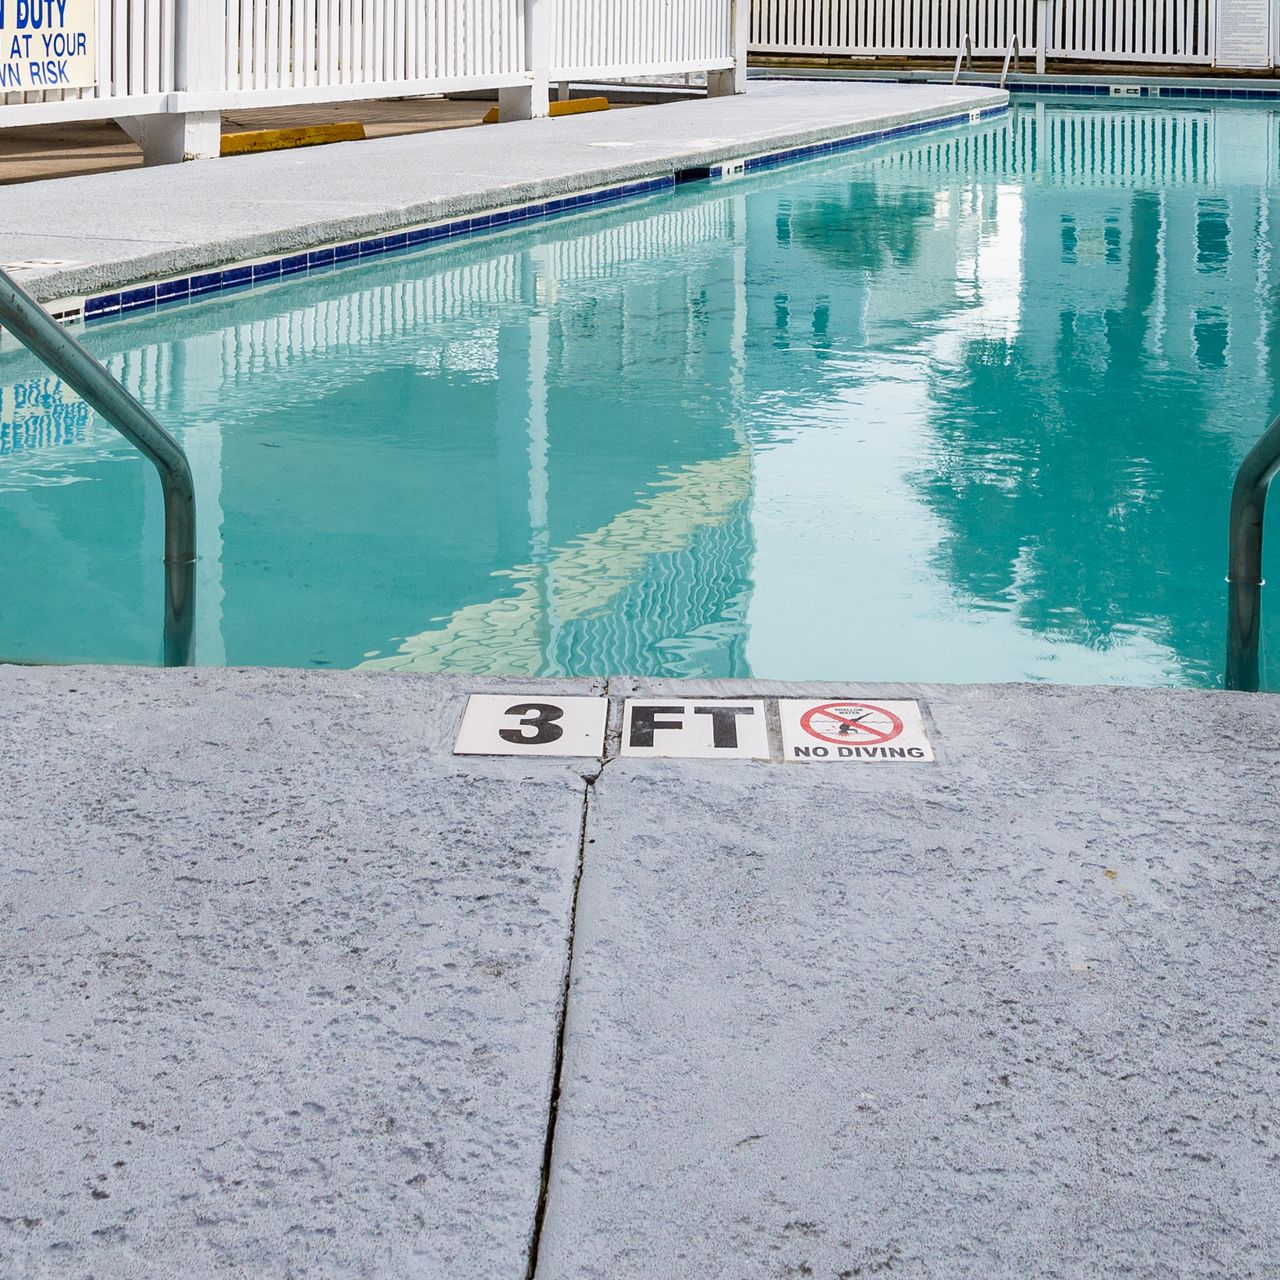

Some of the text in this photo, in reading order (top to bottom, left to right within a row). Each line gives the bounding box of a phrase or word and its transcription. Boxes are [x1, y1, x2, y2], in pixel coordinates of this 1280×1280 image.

[10, 34, 32, 59] AT
[41, 32, 87, 58] YOUR
[29, 60, 70, 86] RISK
[498, 702, 755, 749] 3 FT
[793, 746, 925, 758] NO DIVING
